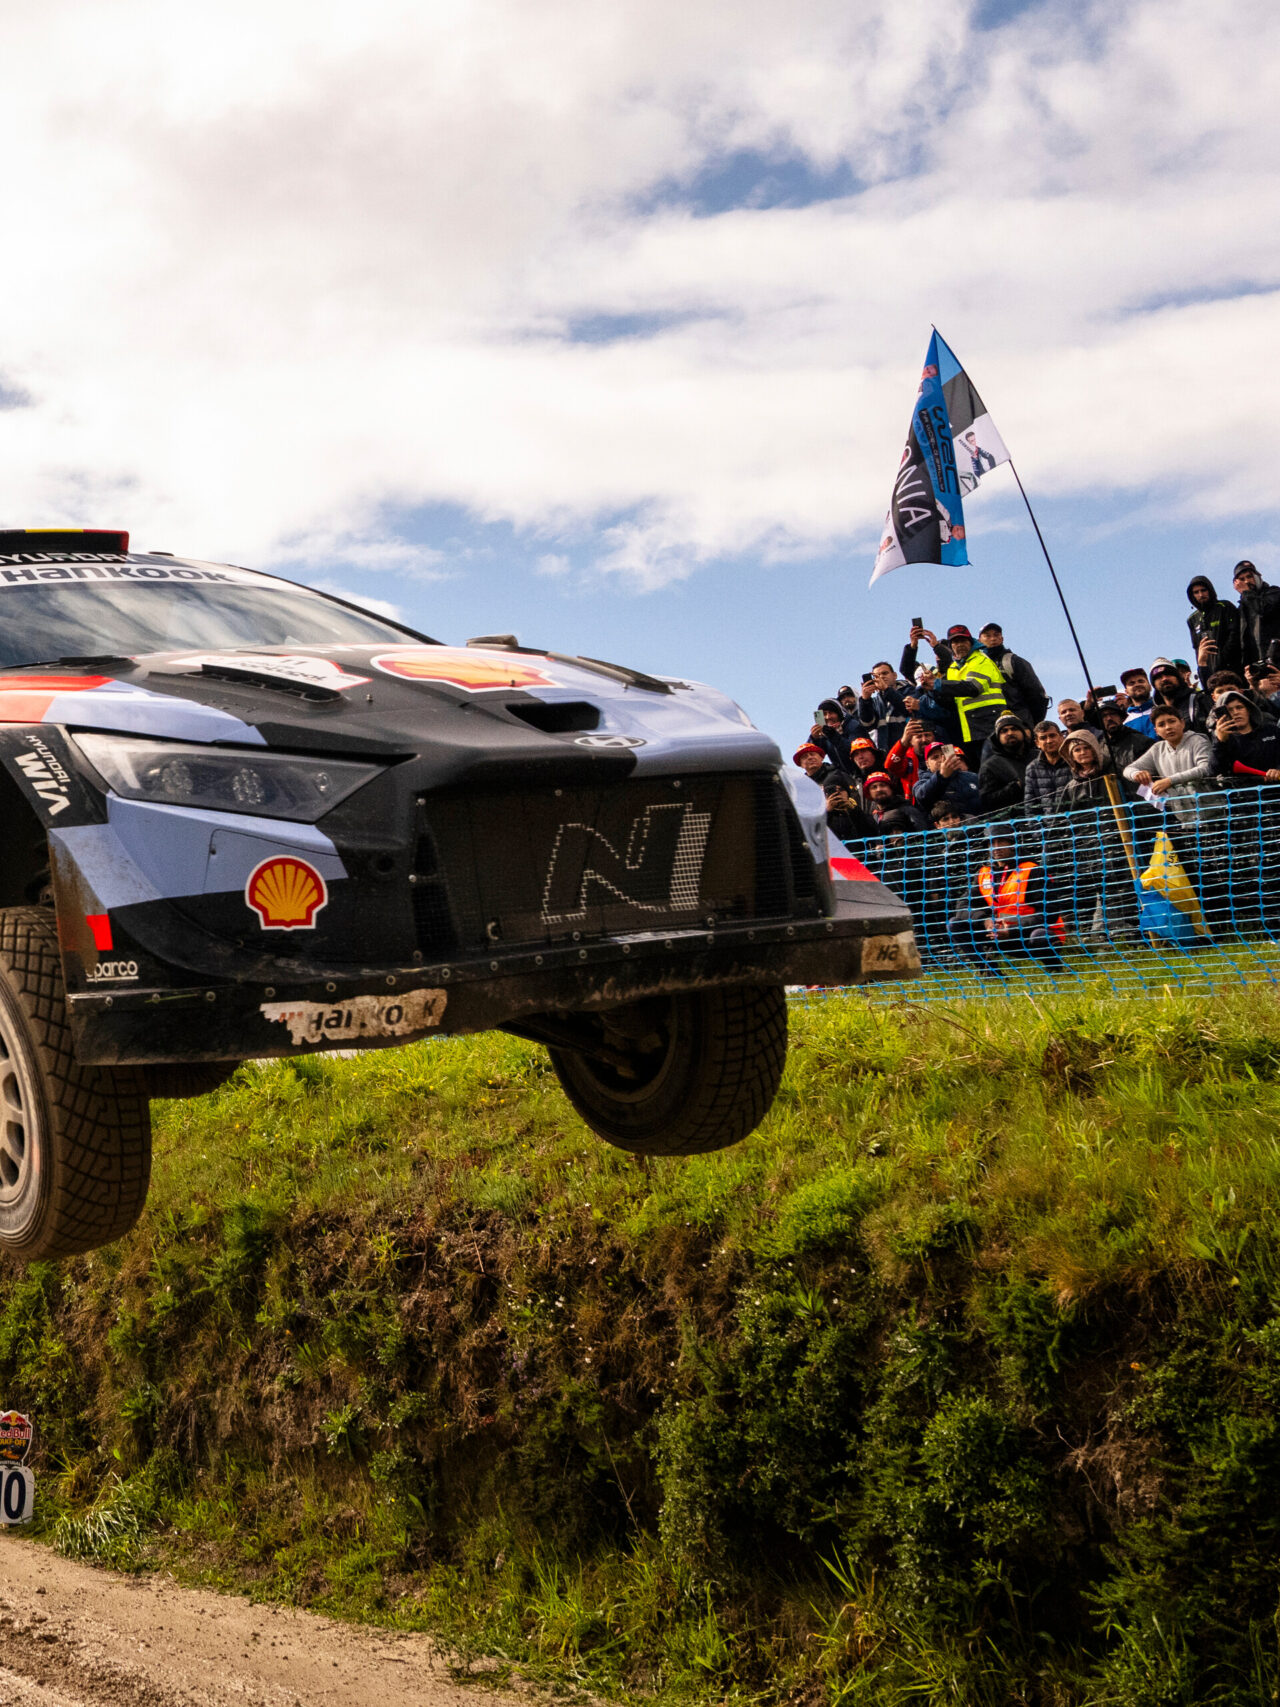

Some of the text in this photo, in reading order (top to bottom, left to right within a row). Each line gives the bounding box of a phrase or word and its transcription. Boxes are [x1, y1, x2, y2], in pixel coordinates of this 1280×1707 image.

[26, 735, 71, 783] HYUNDAI
[15, 752, 71, 816] WIA
[13, 1428, 31, 1439] Bull
